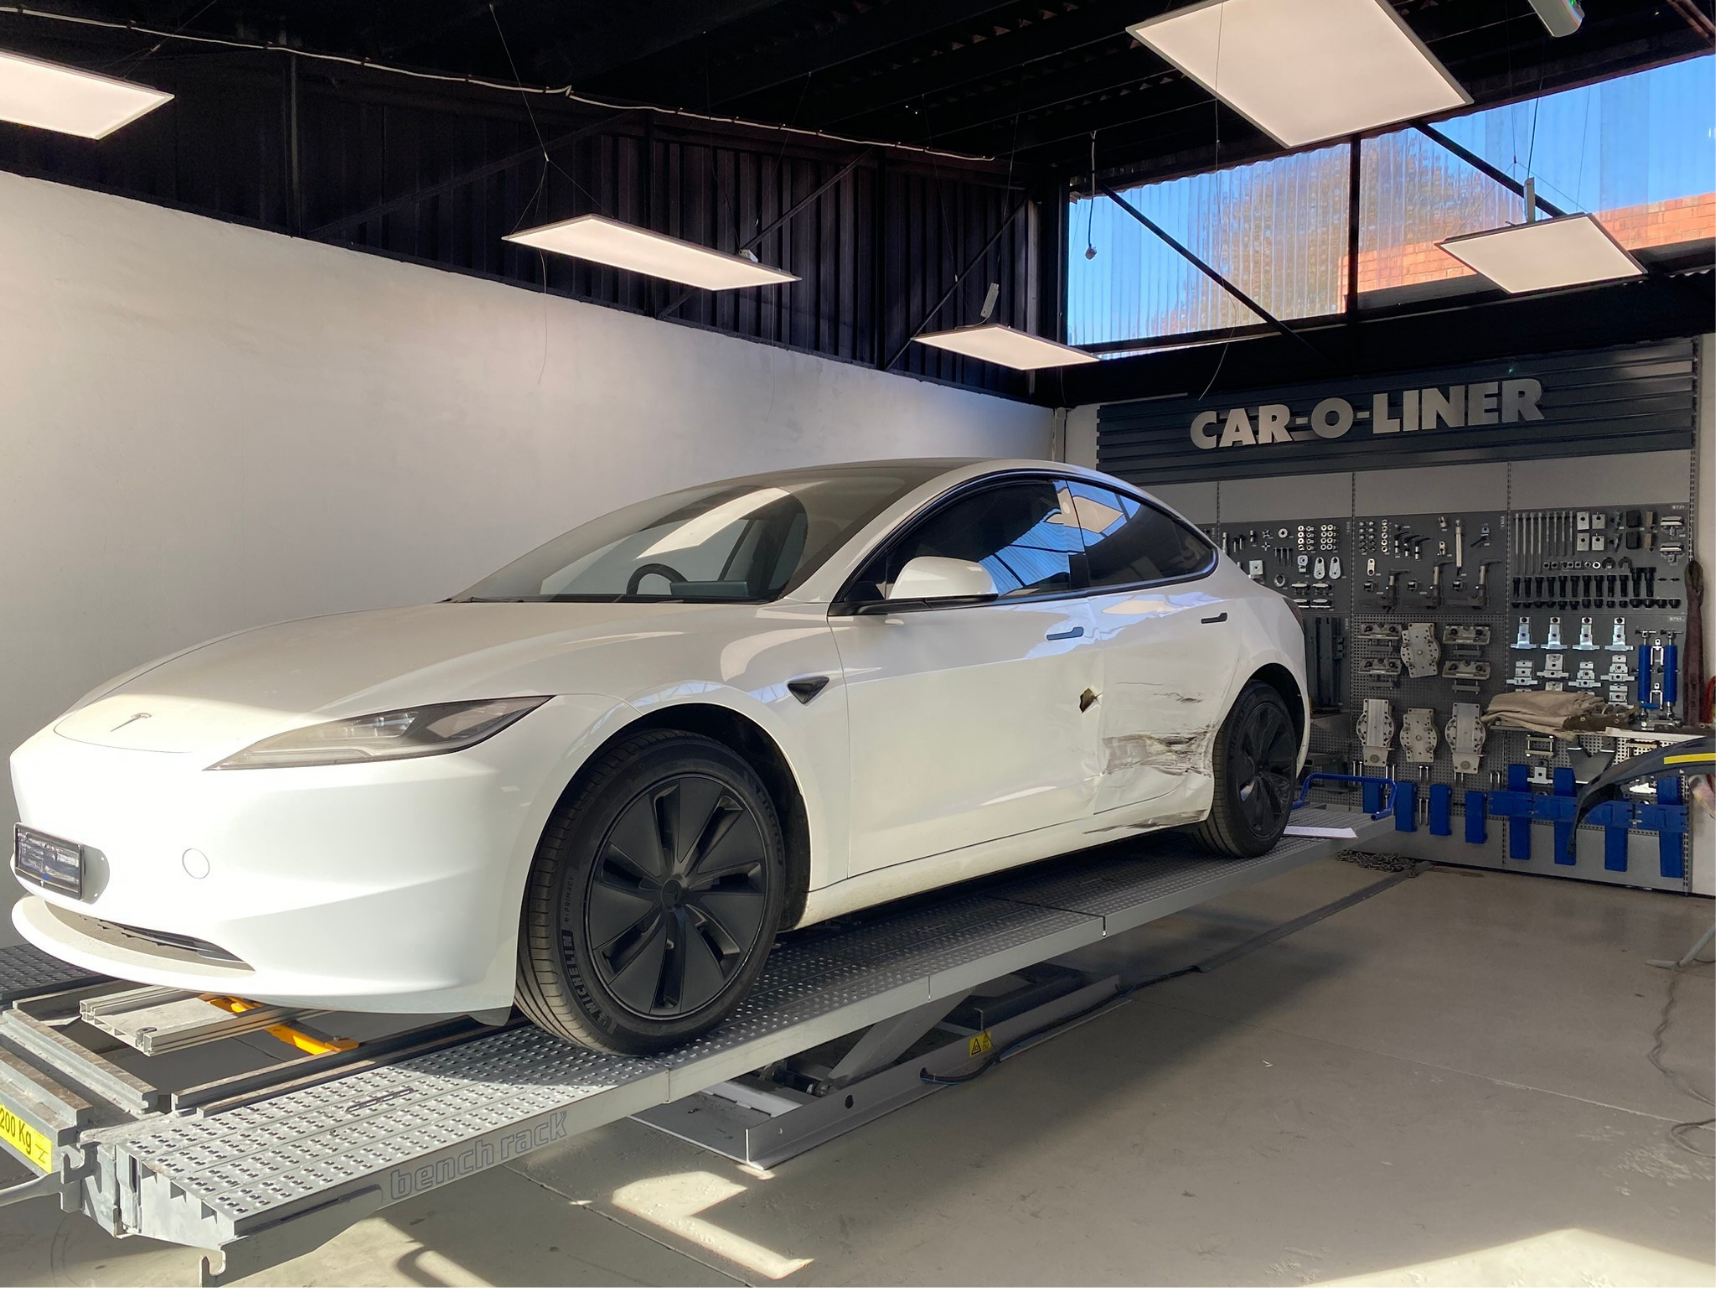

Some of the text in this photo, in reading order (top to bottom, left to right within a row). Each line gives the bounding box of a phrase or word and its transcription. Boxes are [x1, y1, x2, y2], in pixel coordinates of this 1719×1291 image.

[1190, 378, 1545, 450] CAR-O-LINER
[562, 934, 600, 1016] MICHELIN
[18, 1119, 32, 1156] Kg
[390, 1139, 495, 1201] bench
[500, 1112, 568, 1161] rack
